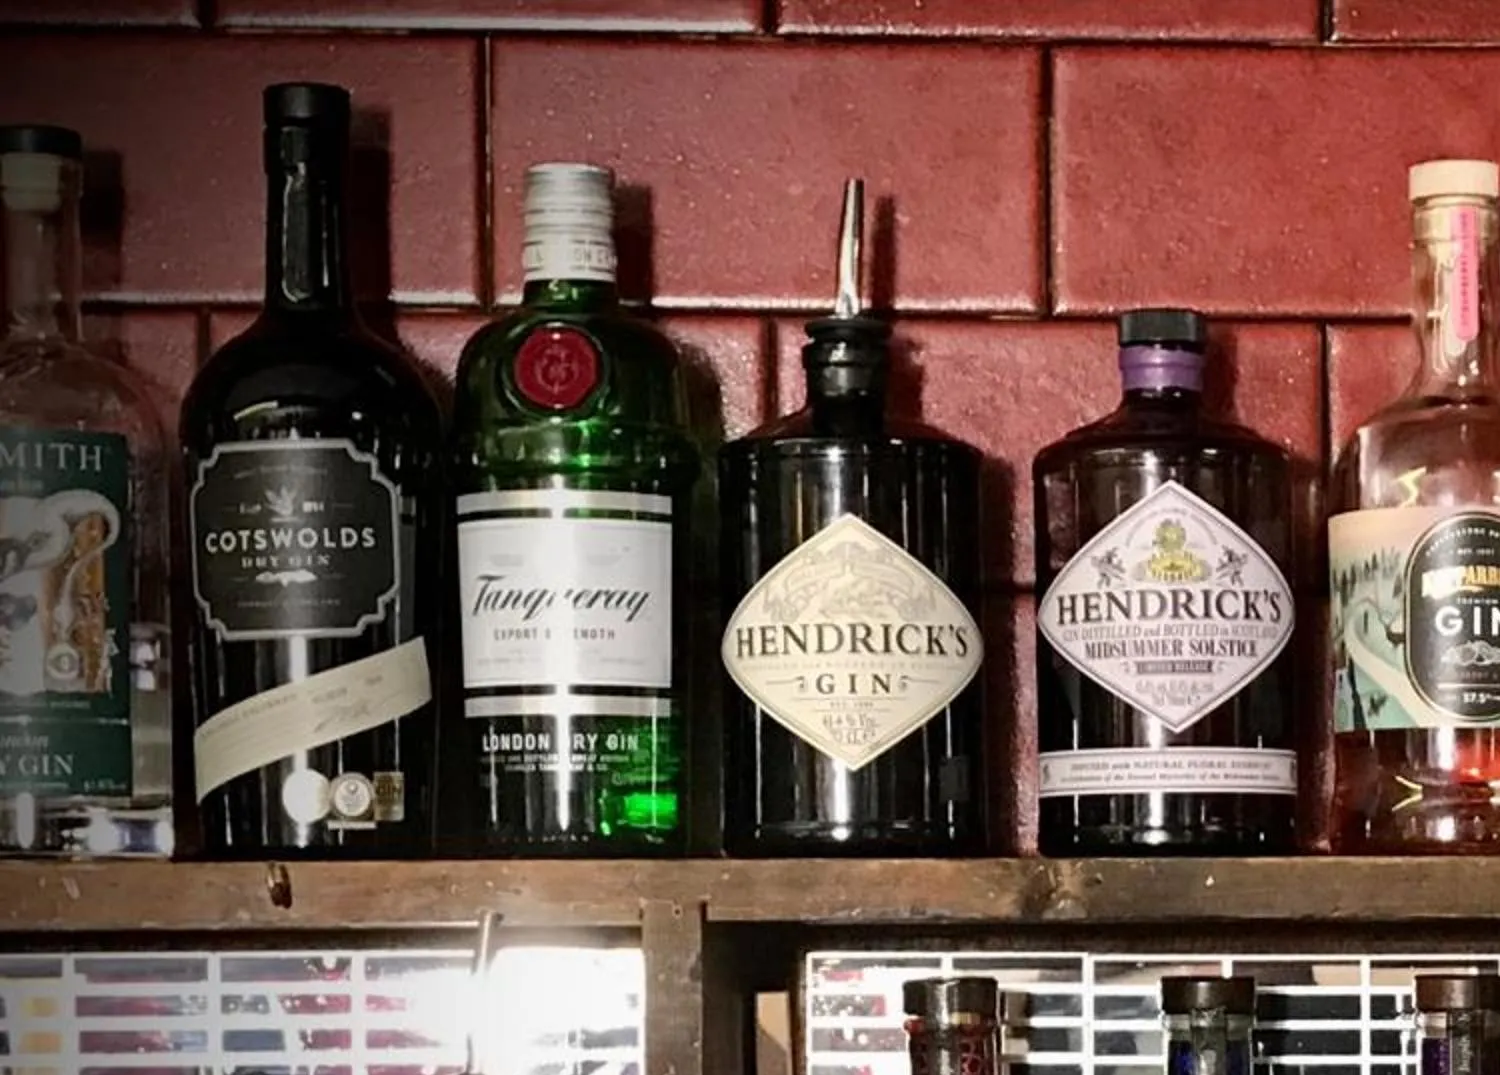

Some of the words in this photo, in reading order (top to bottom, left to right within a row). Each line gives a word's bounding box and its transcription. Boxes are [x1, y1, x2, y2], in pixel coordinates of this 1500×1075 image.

[205, 527, 376, 553] COTSWOLDS
[241, 556, 279, 569] DRY
[288, 554, 331, 567] GIN
[473, 574, 651, 622] Tanqeray
[1057, 588, 1281, 625] HENDRICK'S
[494, 627, 538, 641] EXPORT
[736, 622, 969, 658] HENDRICK'S
[1163, 623, 1219, 638] BOTTLED
[1084, 639, 1183, 659] MIDSUMMER
[1189, 639, 1258, 658] SOLSTICE
[815, 673, 892, 695] GIN
[482, 733, 550, 751] LONDON
[572, 732, 598, 750] RY
[605, 733, 640, 751] GIN
[17, 753, 74, 775] GIN
